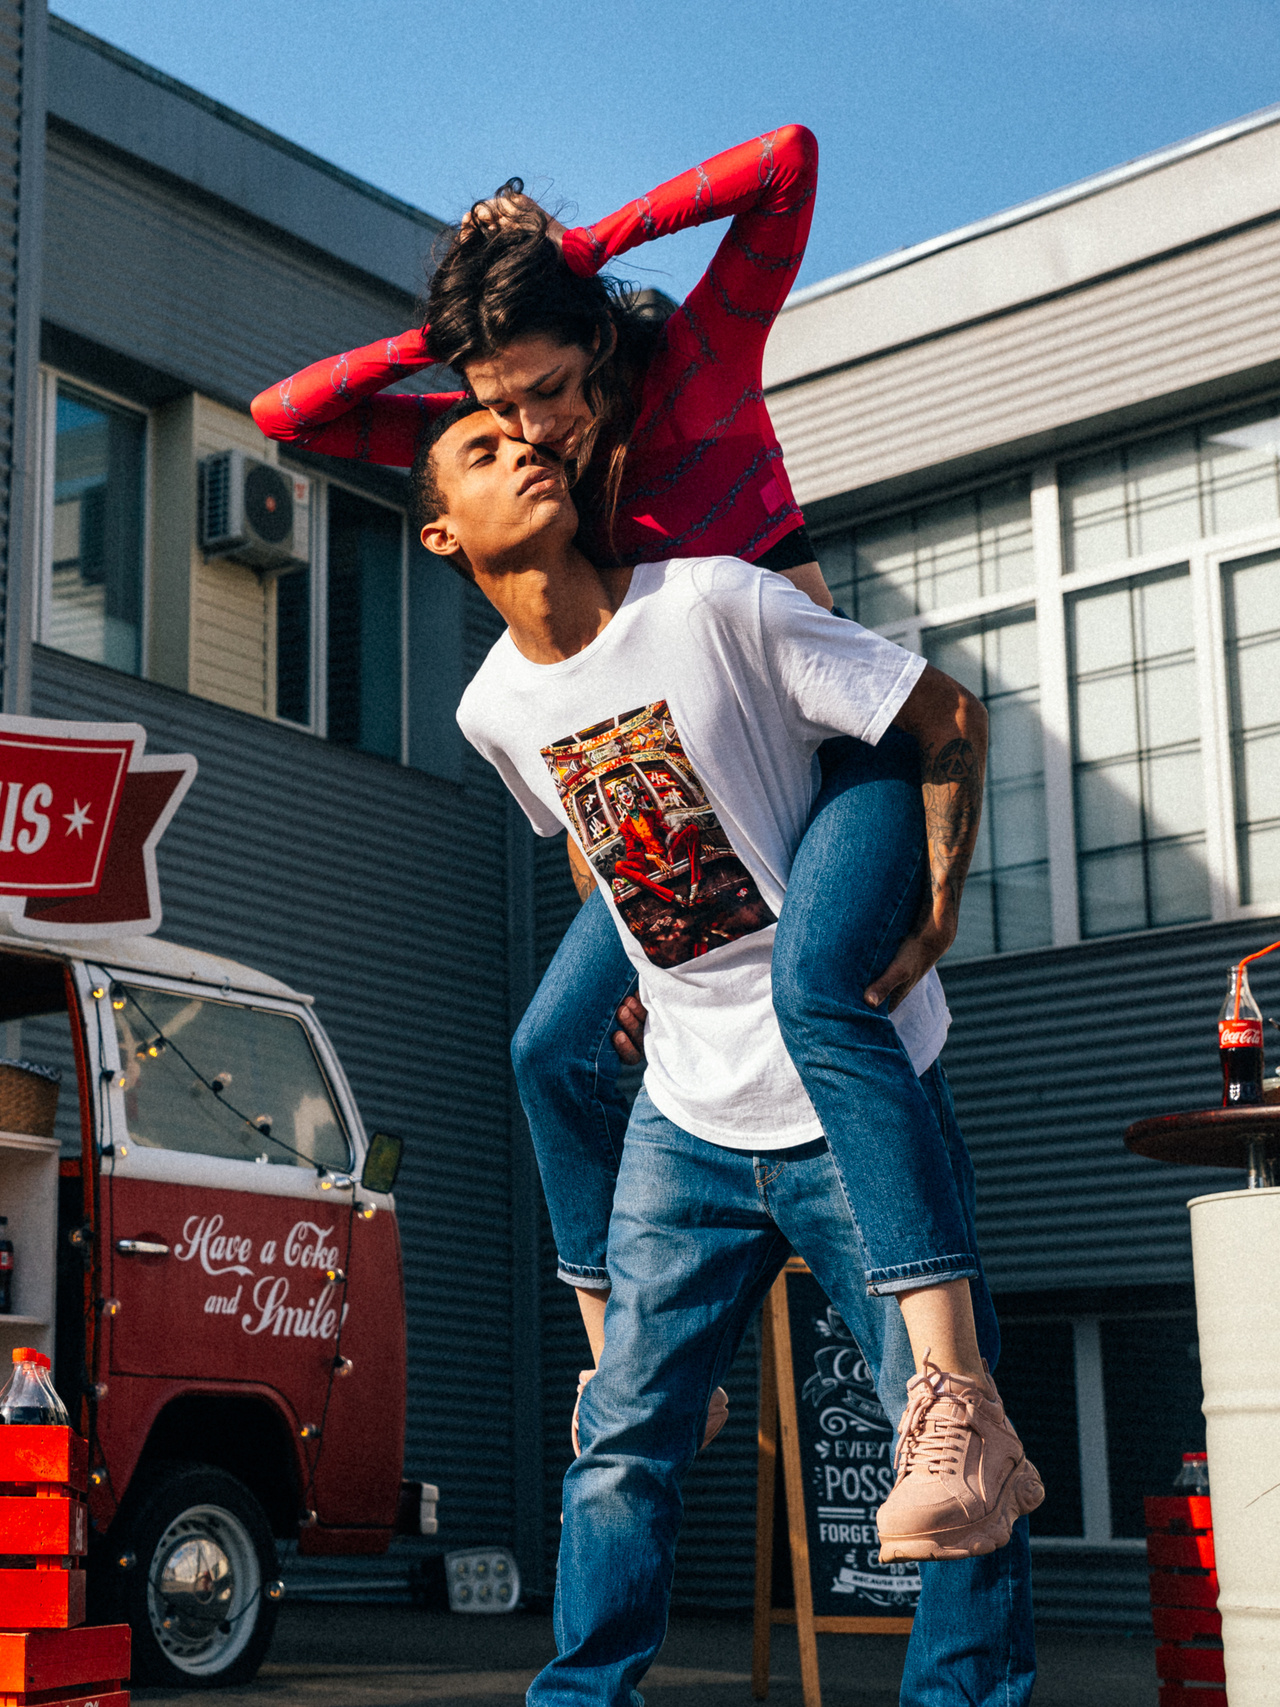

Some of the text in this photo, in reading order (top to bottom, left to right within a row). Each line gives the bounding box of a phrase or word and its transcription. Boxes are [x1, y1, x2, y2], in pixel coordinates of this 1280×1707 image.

[174, 1214, 339, 1276] Have a Coke
[204, 1276, 349, 1340] and Smile!
